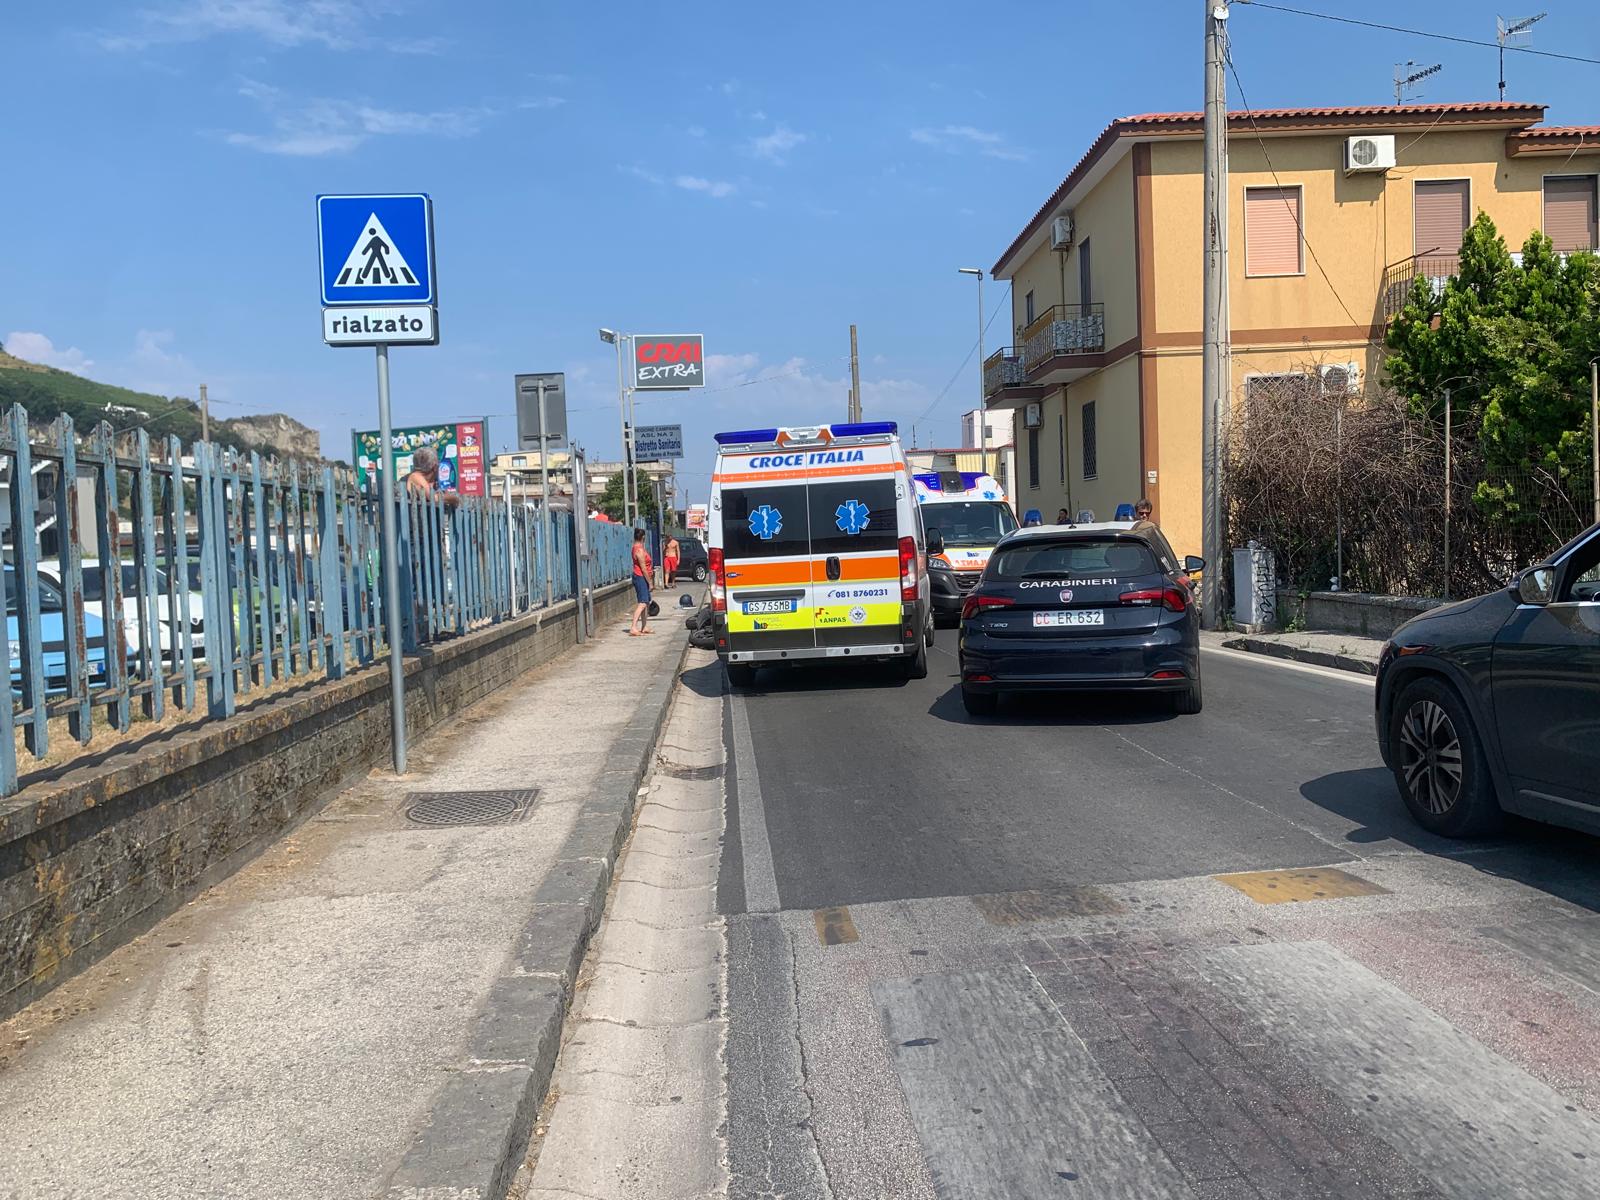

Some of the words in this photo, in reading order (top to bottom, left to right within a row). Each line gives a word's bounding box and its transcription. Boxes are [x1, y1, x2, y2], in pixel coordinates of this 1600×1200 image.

[332, 314, 423, 334] rialzato
[637, 342, 701, 364] CRAI
[638, 363, 700, 380] EXTRA
[634, 440, 658, 452] Distretto
[658, 438, 681, 450] Sanitario
[749, 454, 804, 468] CROCE
[809, 450, 864, 465] ITALIA
[1019, 578, 1118, 589] CARABINIERI
[853, 589, 888, 598] 8760231
[1035, 612, 1051, 625] CC
[1057, 611, 1072, 624] ER
[1077, 611, 1101, 624] 632
